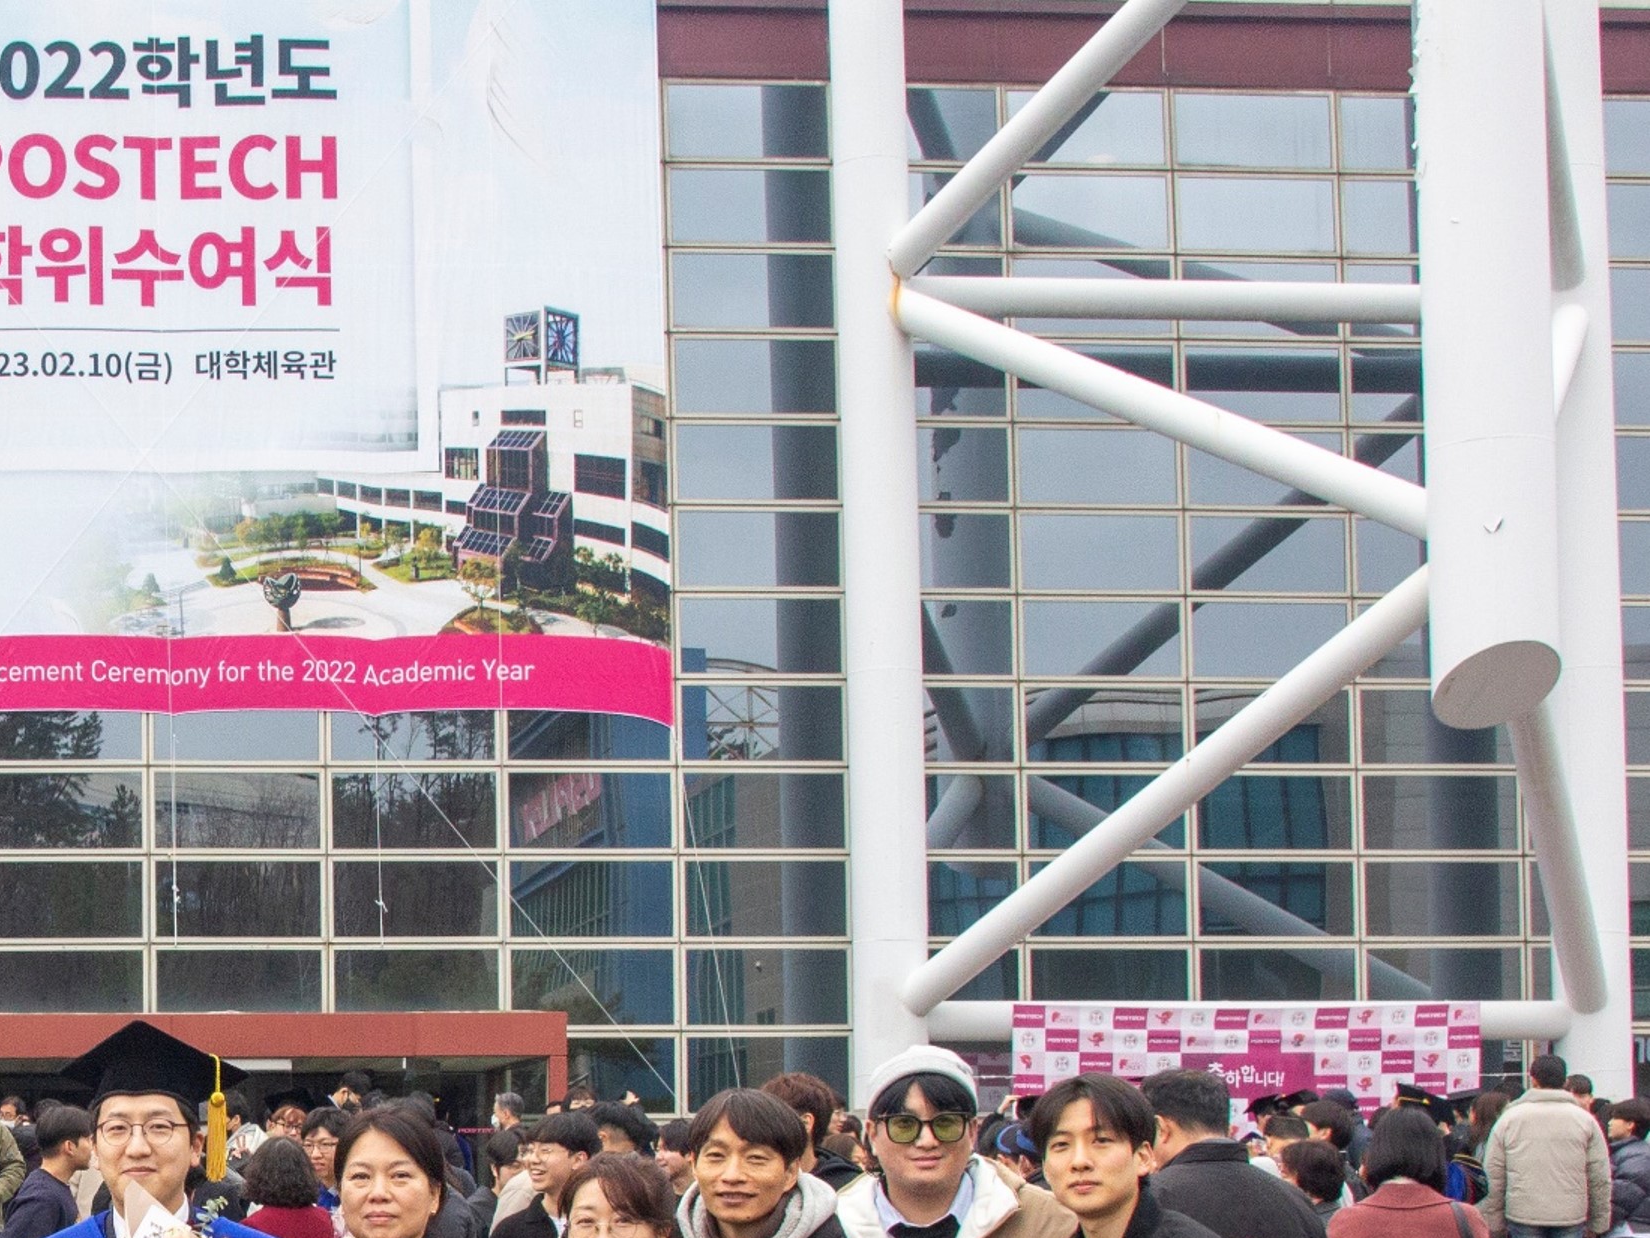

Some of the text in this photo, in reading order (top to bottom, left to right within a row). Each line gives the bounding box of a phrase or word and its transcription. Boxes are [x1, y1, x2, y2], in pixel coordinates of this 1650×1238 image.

[195, 350, 337, 381] 대학체육관
[91, 660, 211, 688] Ceremony
[218, 660, 251, 682] for
[257, 660, 294, 682] the
[301, 659, 356, 684] 2022
[362, 659, 475, 687] Academic
[481, 658, 535, 682] Year
